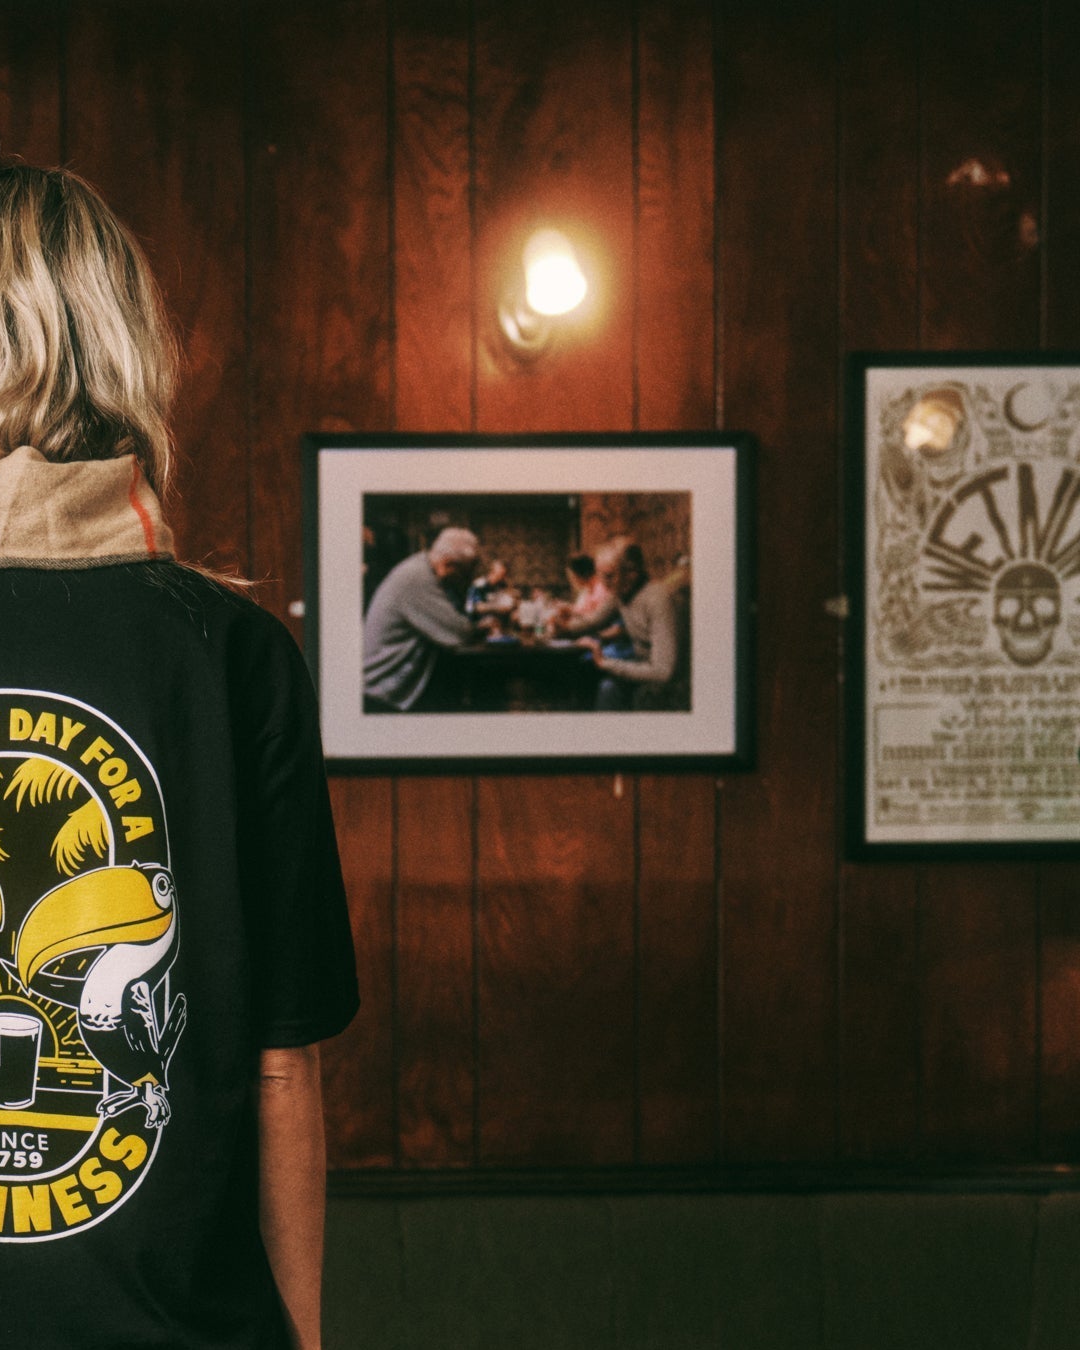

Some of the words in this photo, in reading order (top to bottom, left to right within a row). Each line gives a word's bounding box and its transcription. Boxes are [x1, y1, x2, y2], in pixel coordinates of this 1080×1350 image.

[9, 708, 86, 751] DAY
[79, 736, 142, 809] FOR
[121, 815, 155, 843] A
